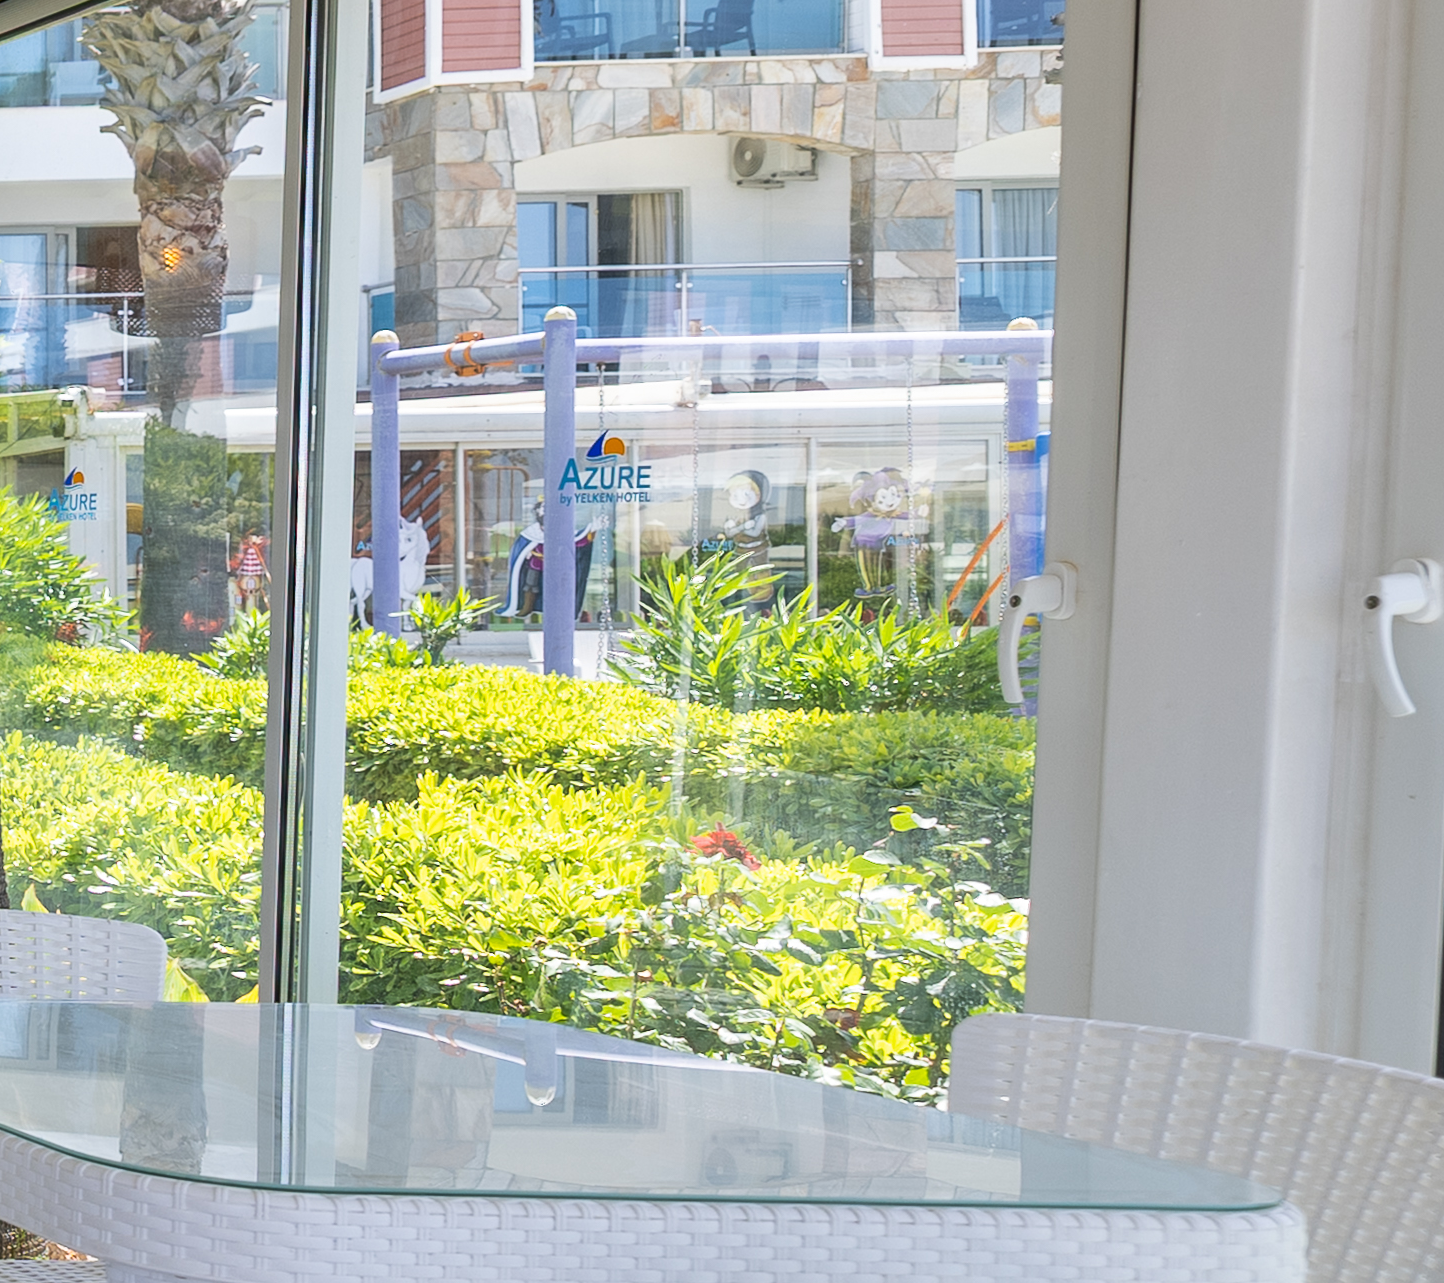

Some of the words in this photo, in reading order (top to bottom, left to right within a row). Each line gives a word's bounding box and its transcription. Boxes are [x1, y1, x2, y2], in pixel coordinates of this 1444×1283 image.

[558, 458, 652, 491] AZURE
[559, 493, 573, 506] by
[574, 493, 613, 504] YELKEN
[616, 492, 651, 503] HOTEL
